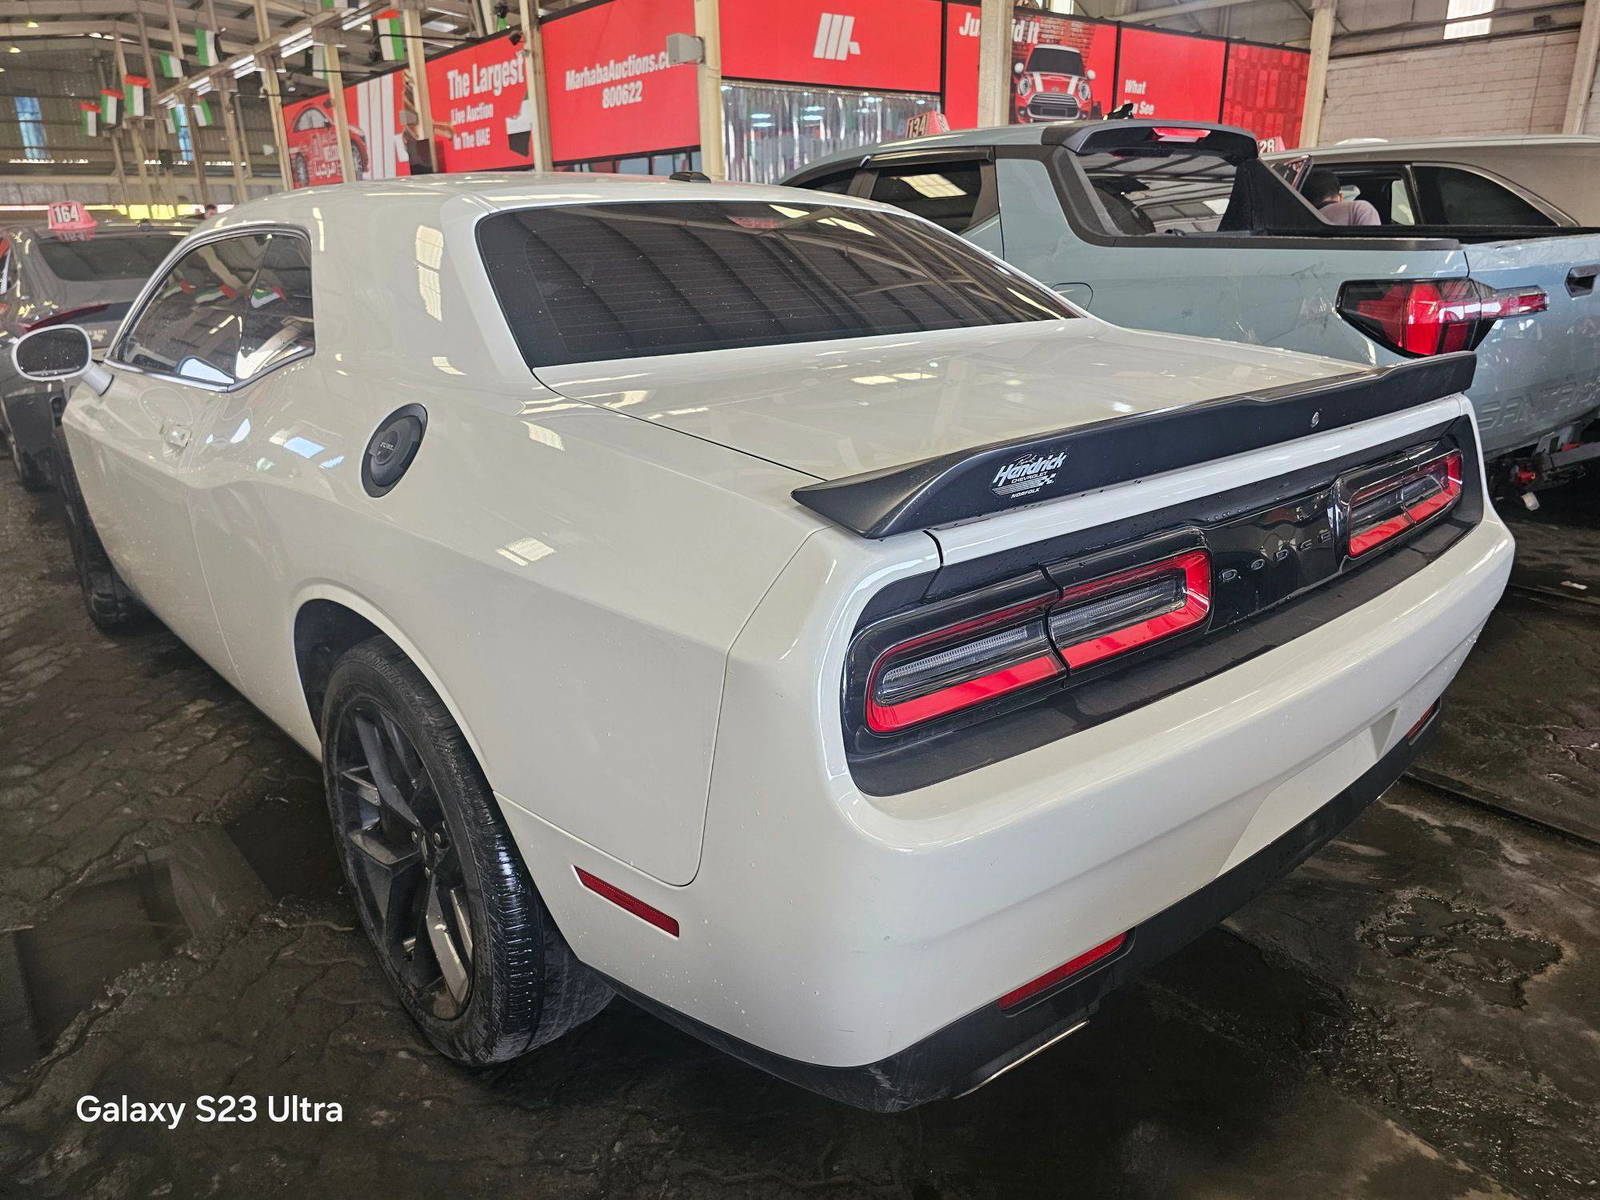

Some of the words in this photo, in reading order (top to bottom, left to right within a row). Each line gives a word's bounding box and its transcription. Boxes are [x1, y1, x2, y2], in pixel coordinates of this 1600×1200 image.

[959, 12, 981, 37] Ju
[1011, 19, 1025, 42] id
[1026, 21, 1040, 44] It
[447, 69, 470, 100] The
[472, 52, 525, 96] Largest
[565, 51, 671, 91] MarhabaAuctions.c
[602, 80, 643, 109] 800622
[1125, 79, 1146, 95] What
[466, 102, 494, 123] Auction
[1139, 101, 1154, 115] See
[909, 114, 926, 138] 134
[461, 131, 475, 149] The
[475, 127, 490, 147] UAE
[1257, 138, 1276, 154] 28
[54, 205, 80, 223] 164
[992, 451, 1067, 487] Hendrick
[1011, 471, 1048, 484] CHEVROLET
[1010, 487, 1041, 499] NORFOLK
[1221, 528, 1332, 582] DODGE
